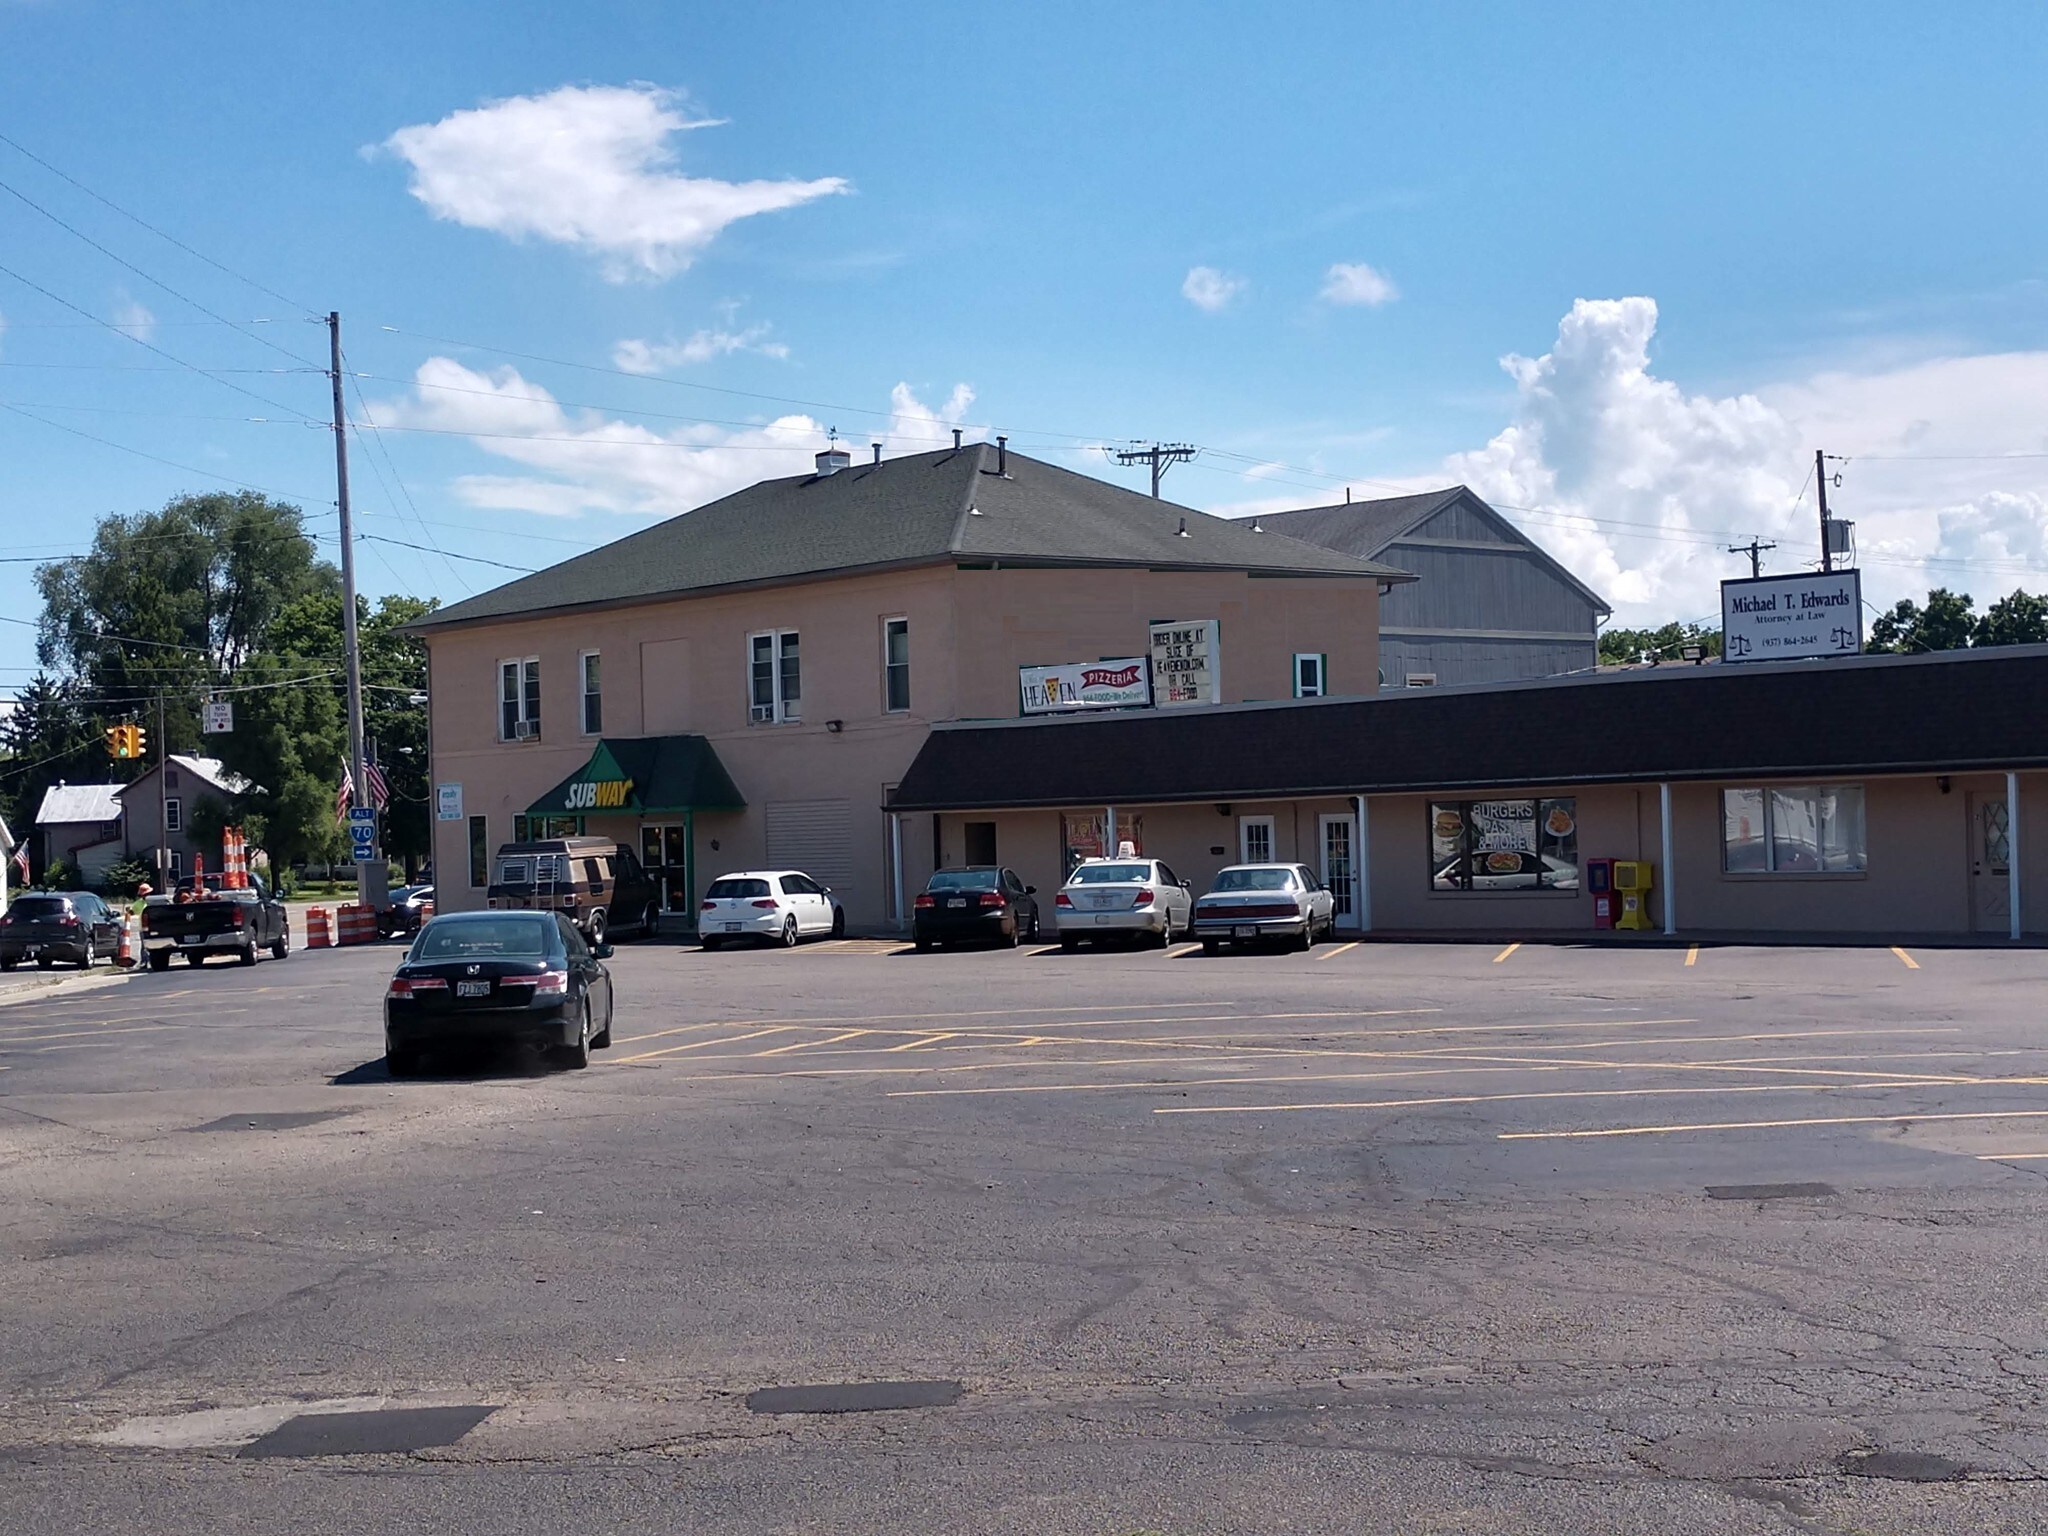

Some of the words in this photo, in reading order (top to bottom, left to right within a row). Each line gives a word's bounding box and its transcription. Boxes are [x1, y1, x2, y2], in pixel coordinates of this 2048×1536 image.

[1731, 594, 1776, 614] Michael
[1784, 594, 1796, 610] T.
[1800, 588, 1850, 609] Edwards
[1754, 614, 1792, 626] Attorney
[1807, 611, 1826, 620] Law
[1195, 629, 1204, 642] AT
[1762, 638, 1781, 648] (937)
[1783, 635, 1818, 647] 864-2645
[1166, 646, 1182, 659] SLICE
[1186, 644, 1194, 656] OF
[1089, 671, 1133, 684] PIZZERIA
[1181, 673, 1197, 686] CALL
[564, 779, 633, 809] SUBWAY
[354, 810, 369, 818] ALT
[1472, 804, 1533, 818] BURGERS
[354, 827, 372, 839] 70
[1483, 820, 1521, 835] PASTA
